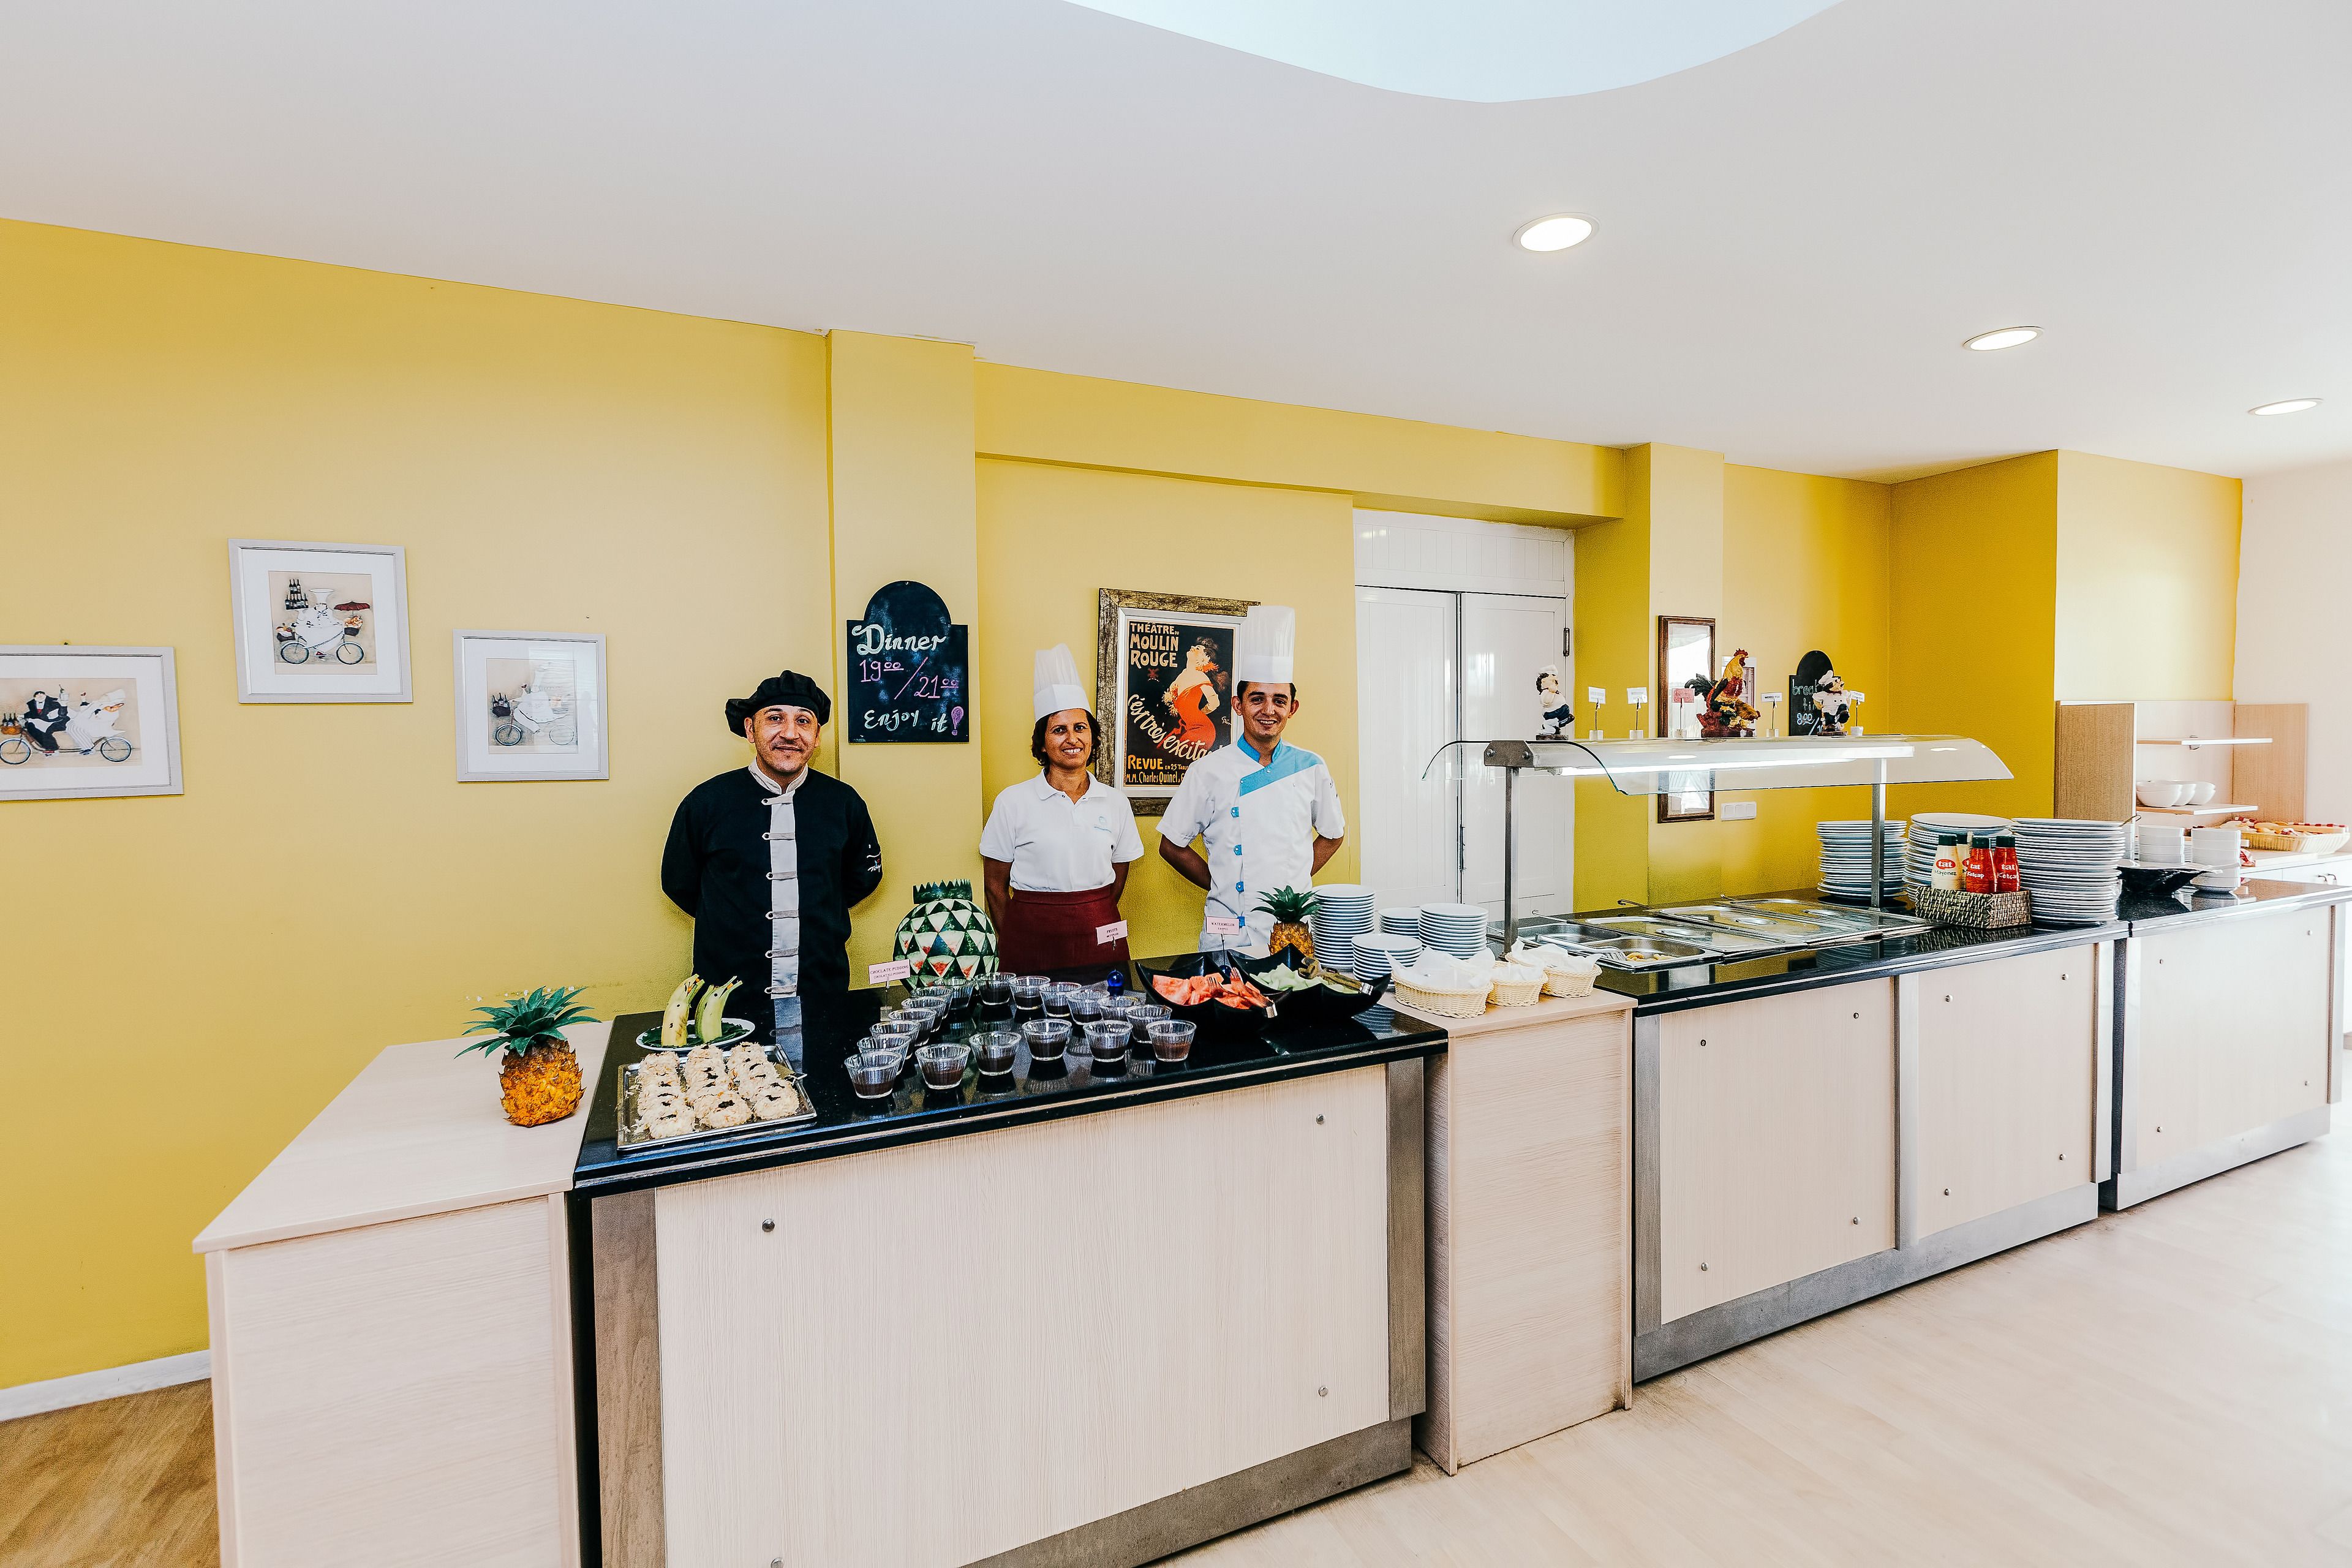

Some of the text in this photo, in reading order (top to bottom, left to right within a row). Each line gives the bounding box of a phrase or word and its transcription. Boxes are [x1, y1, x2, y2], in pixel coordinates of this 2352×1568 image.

[852, 624, 946, 655] Dinner
[1130, 633, 1179, 651] MOULIN
[1131, 650, 1178, 669] ROUGE
[864, 709, 919, 731] Enjoy
[1128, 755, 1163, 770] REVUE
[1139, 771, 1158, 783] Charles
